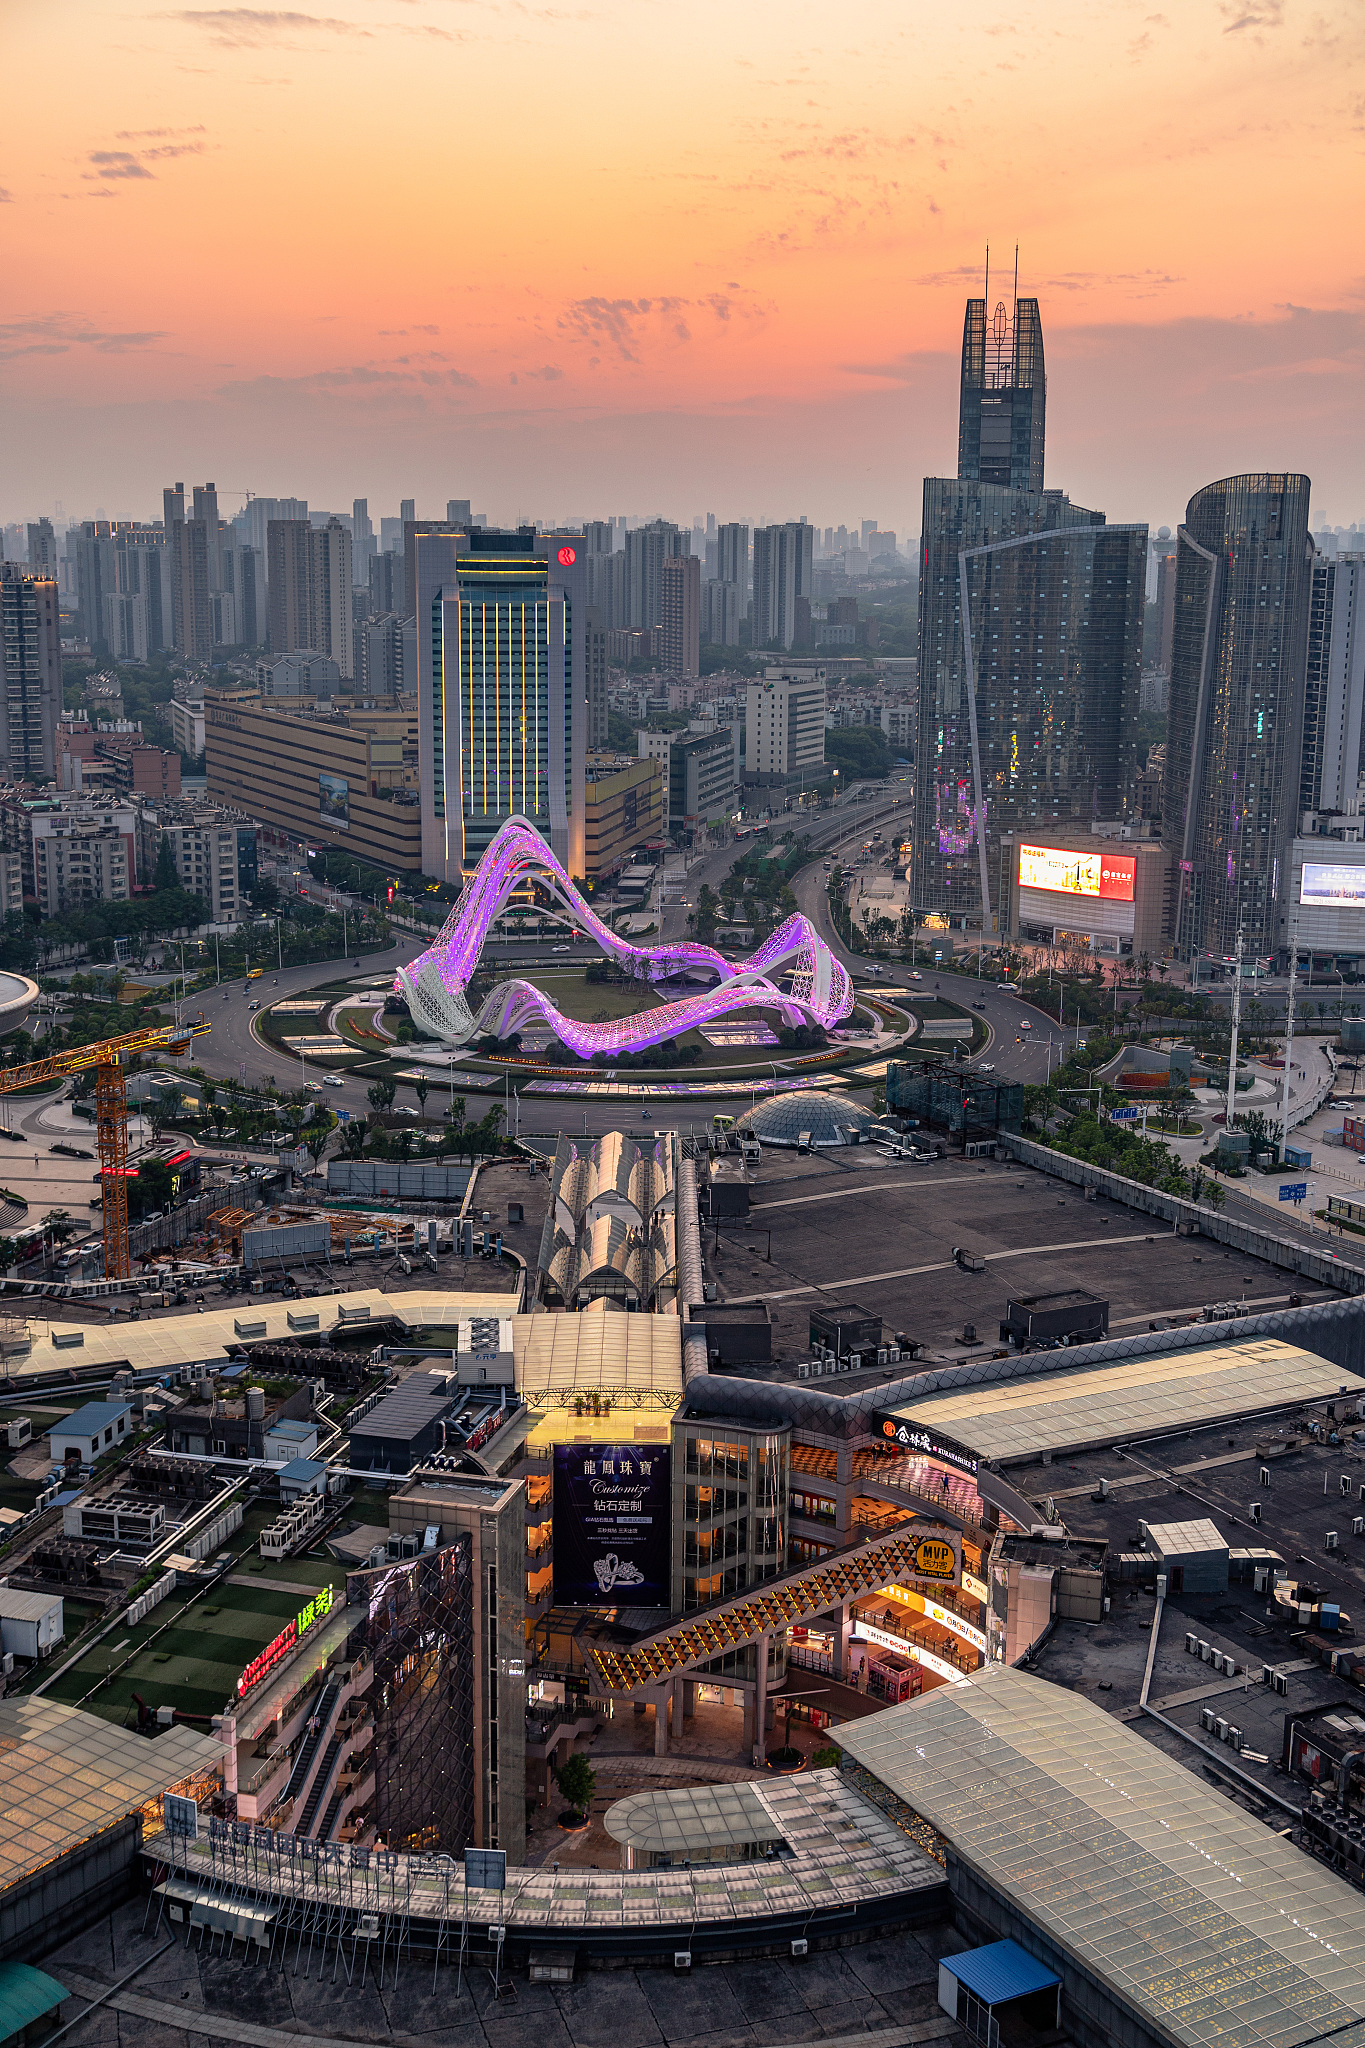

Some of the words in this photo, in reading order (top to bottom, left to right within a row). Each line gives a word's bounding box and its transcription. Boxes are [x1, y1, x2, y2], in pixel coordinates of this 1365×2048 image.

[583, 1460, 652, 1476] 龍鳳珠寶
[589, 1478, 651, 1499] Customize
[593, 1500, 642, 1512] 钻石定制
[922, 1558, 948, 1571] 活力客
